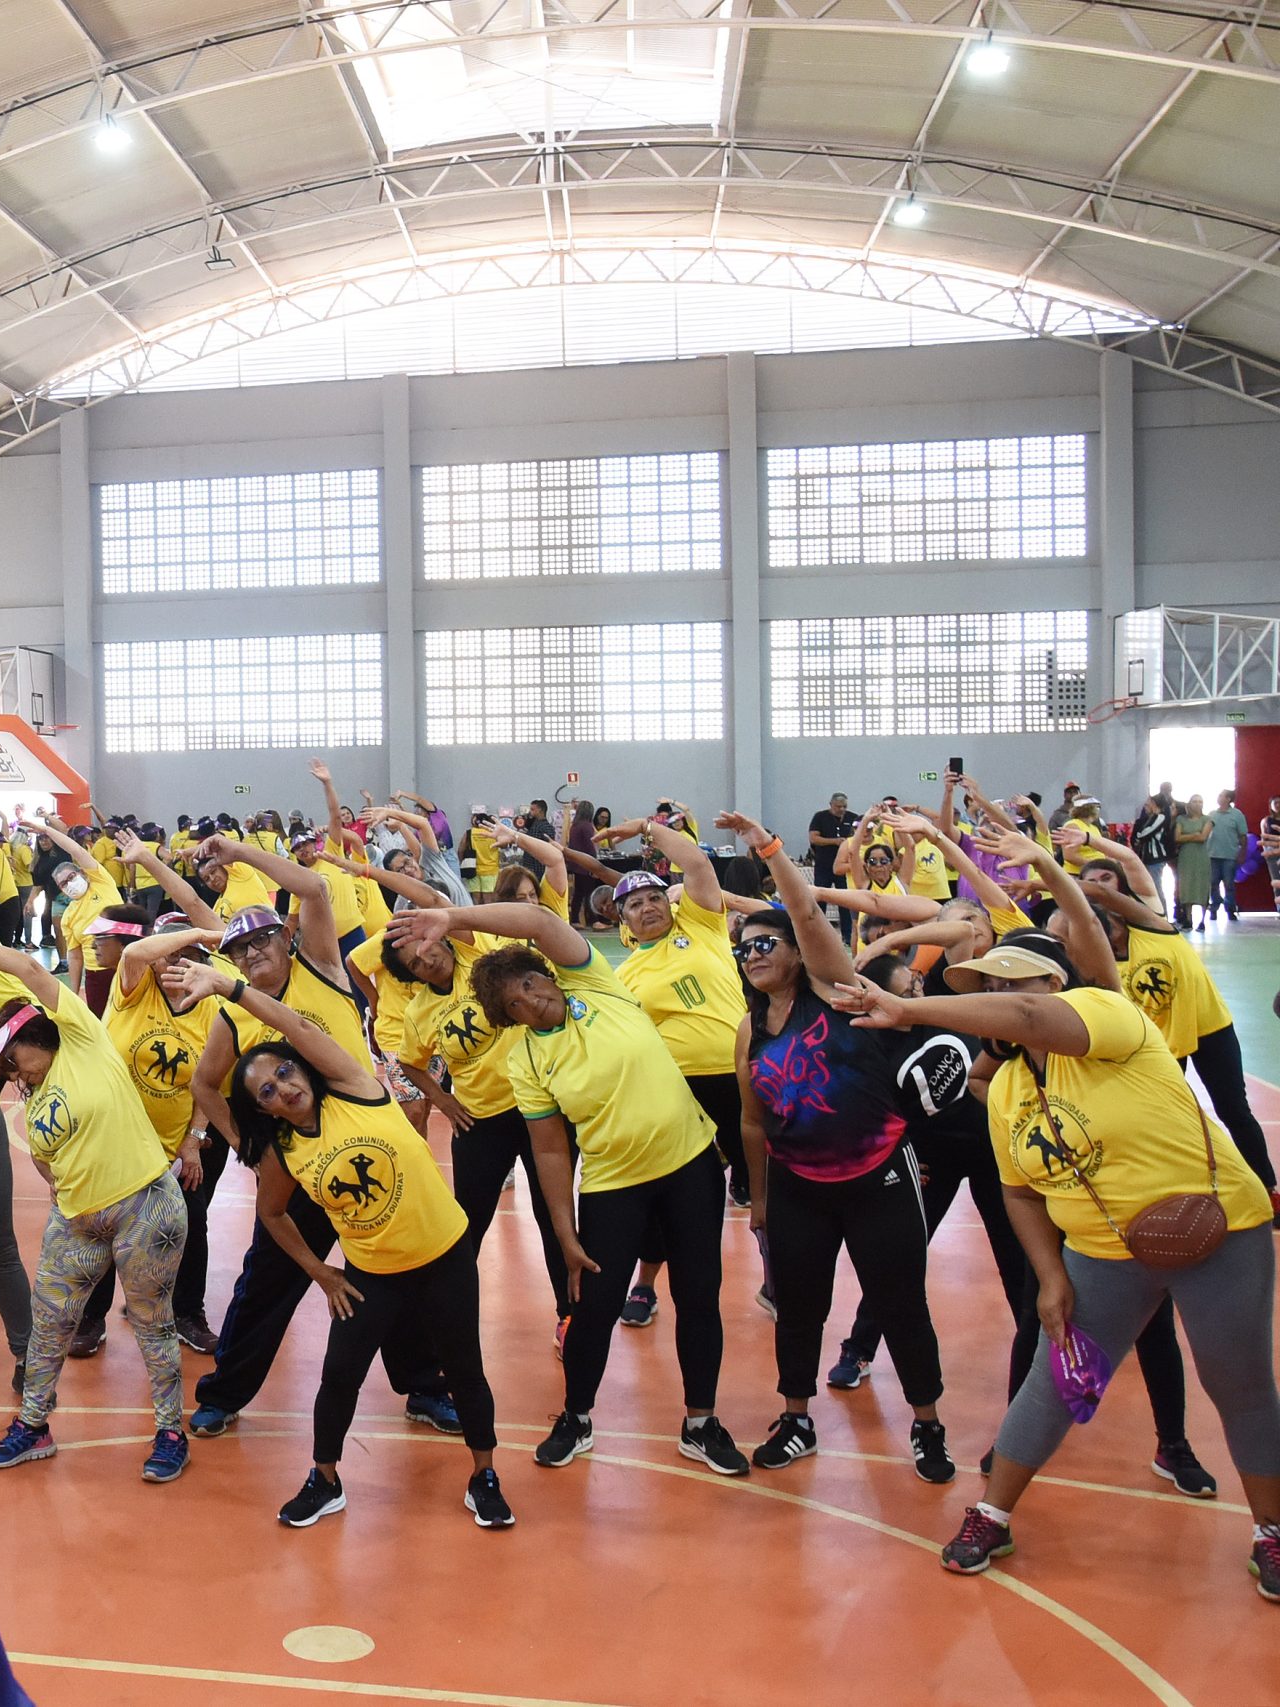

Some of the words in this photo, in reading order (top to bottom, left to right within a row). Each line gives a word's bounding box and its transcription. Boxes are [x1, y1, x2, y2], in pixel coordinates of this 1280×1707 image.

[671, 973, 706, 1010] 10
[314, 1145, 340, 1176] ESCOLA
[343, 1136, 398, 1160] COMUNIDADE
[374, 1211, 392, 1228] NAS
[388, 1171, 405, 1214] QUADRAS
